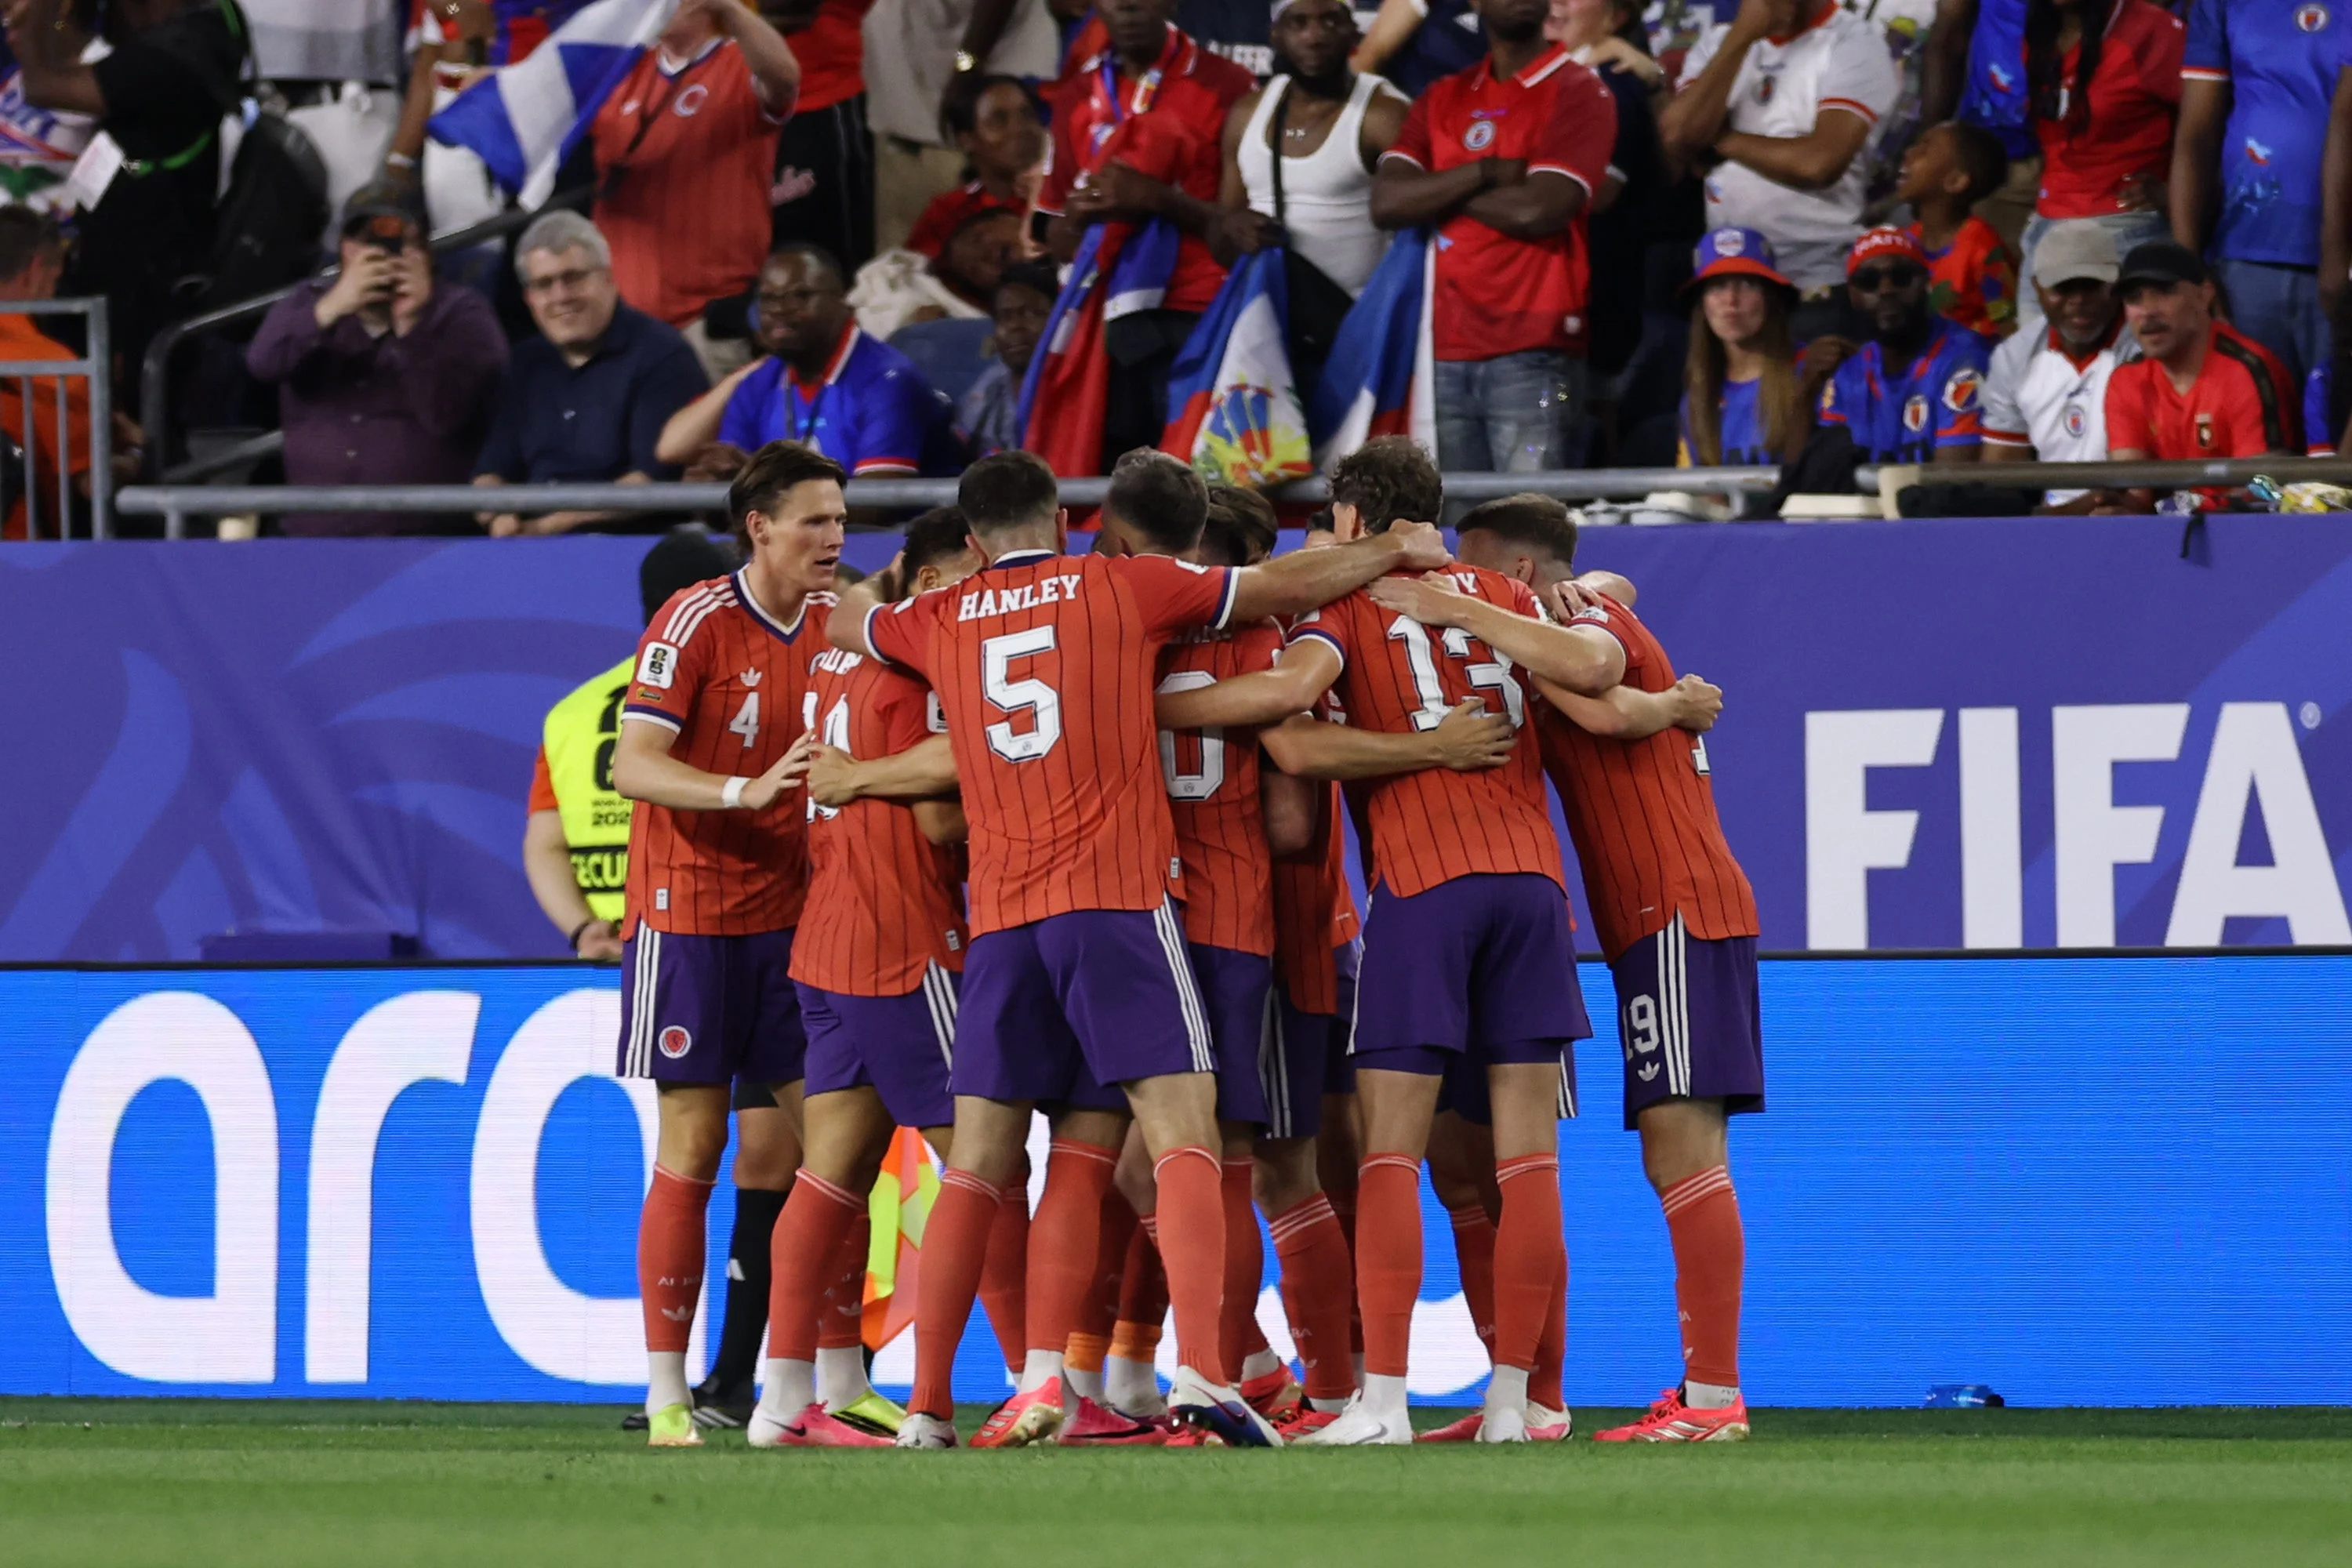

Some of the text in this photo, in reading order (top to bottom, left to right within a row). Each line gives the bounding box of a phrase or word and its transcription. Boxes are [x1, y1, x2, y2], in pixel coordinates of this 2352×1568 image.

[957, 574, 1081, 622] HANLEY
[728, 691, 760, 749] 4
[982, 624, 1062, 764] 5
[1387, 614, 1524, 731] 13
[1805, 700, 2352, 950] FIFA
